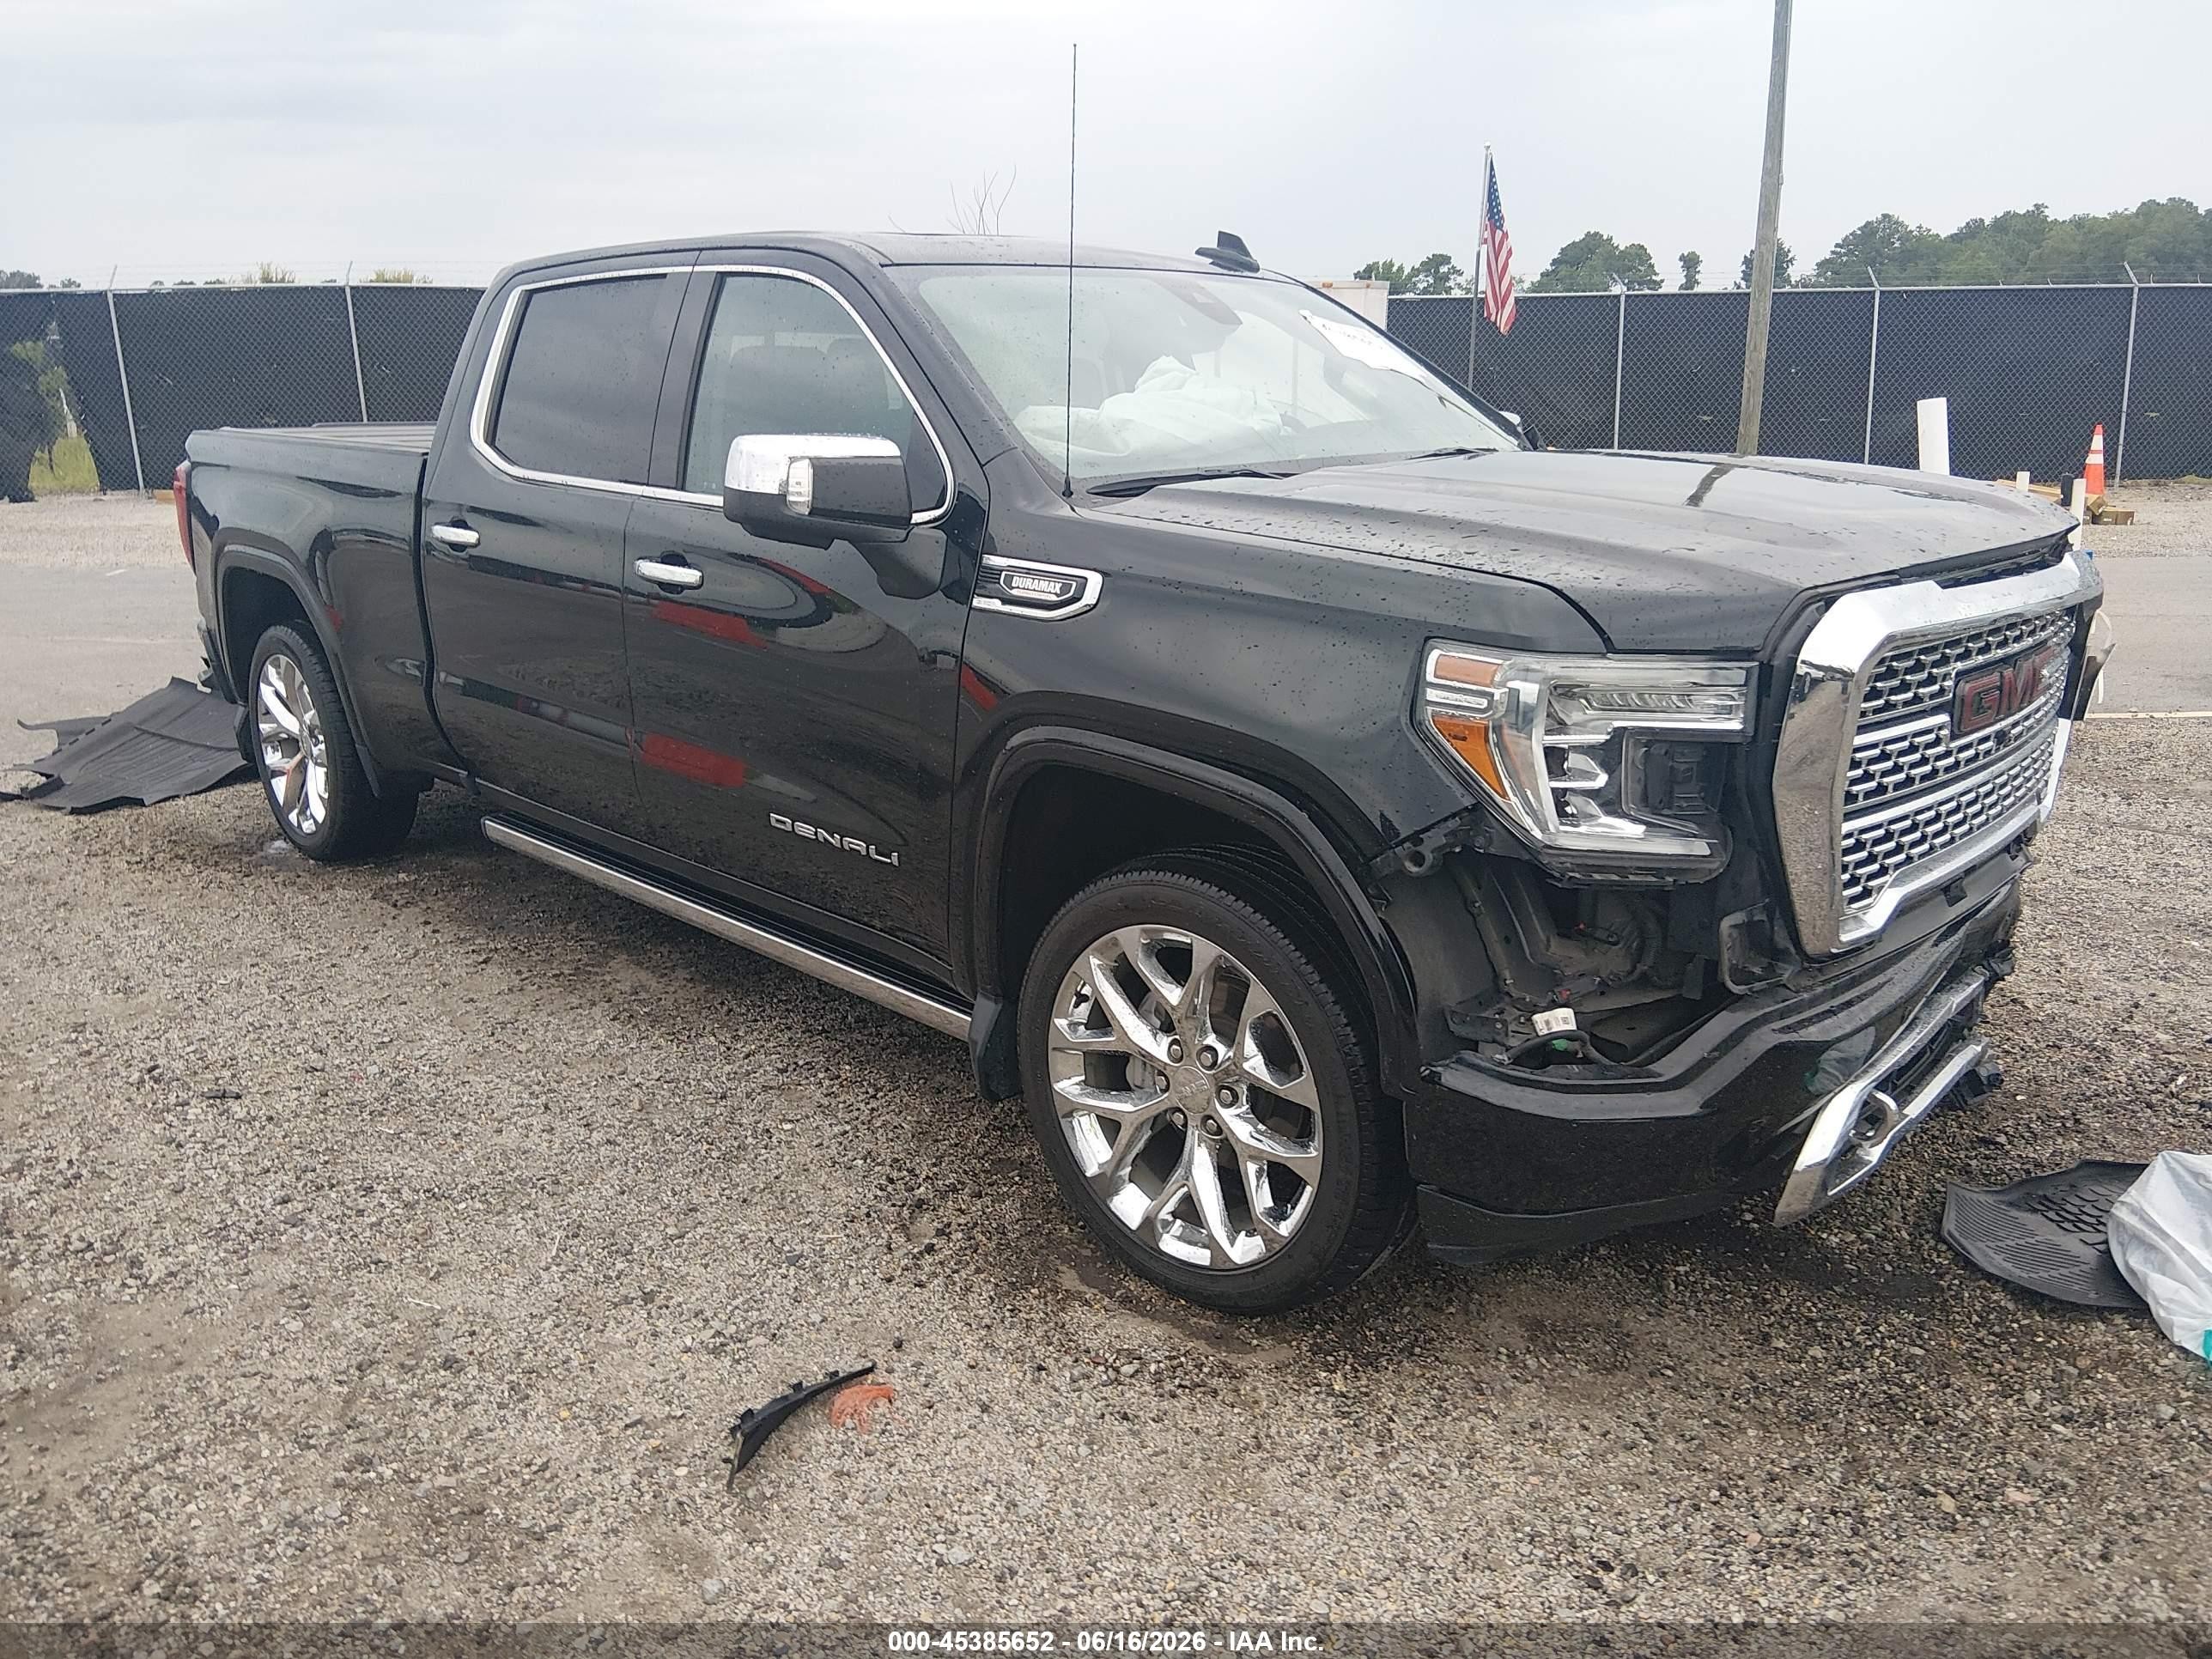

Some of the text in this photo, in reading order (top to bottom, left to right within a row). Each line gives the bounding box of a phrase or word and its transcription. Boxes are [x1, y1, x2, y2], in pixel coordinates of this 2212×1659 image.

[1012, 575, 1062, 594] DURAMAX
[1954, 645, 2057, 734] GMC
[769, 812, 899, 866] DENALI
